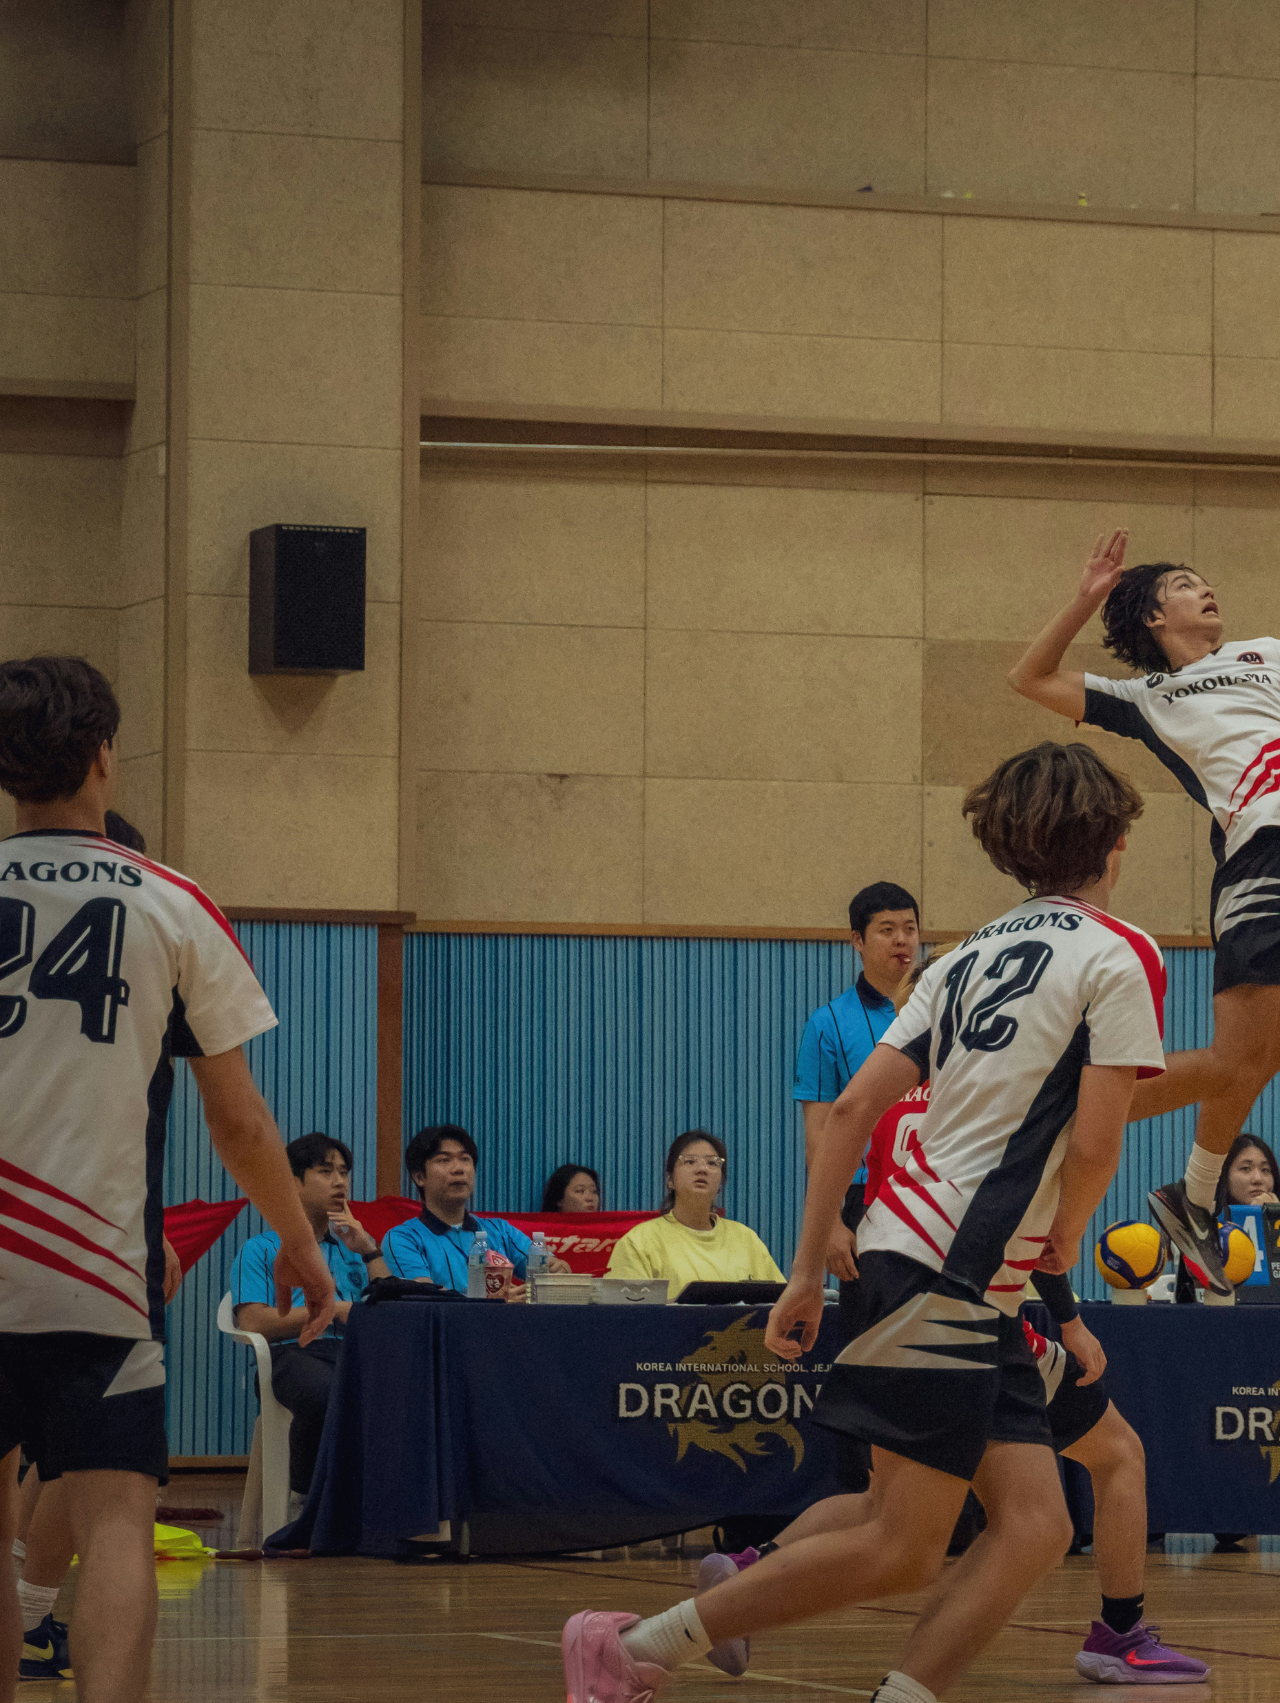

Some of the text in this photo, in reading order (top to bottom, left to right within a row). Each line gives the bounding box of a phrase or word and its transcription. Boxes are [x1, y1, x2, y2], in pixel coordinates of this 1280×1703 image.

[1162, 673, 1272, 706] YOKOHAMA
[961, 911, 1084, 950] DRAGONS
[935, 940, 1054, 1071] 12
[636, 1362, 673, 1372] KOREA
[675, 1362, 761, 1373] INTERNATIONAL
[811, 1364, 833, 1373] JEJ
[1232, 1386, 1265, 1396] KOREA
